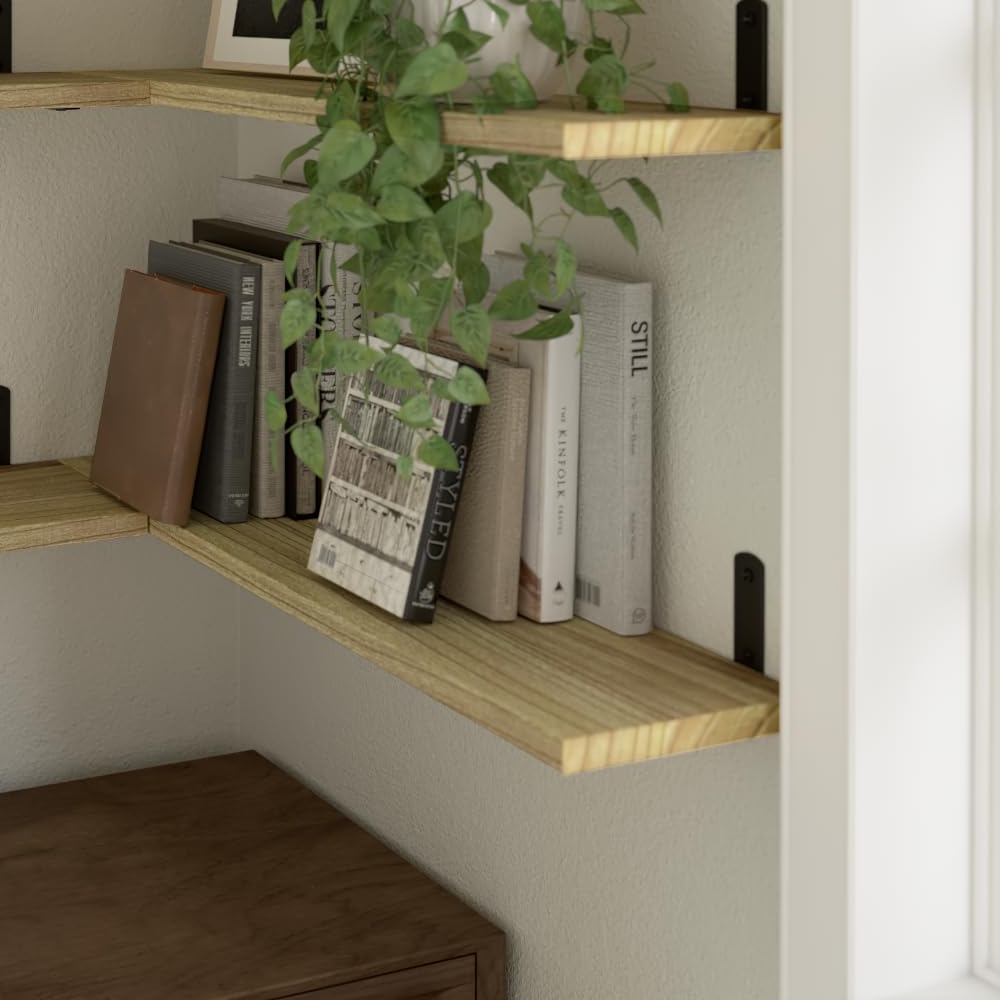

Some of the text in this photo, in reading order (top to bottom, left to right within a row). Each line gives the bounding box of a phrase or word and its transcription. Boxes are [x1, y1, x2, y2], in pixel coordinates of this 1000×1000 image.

[241, 276, 256, 296] NEW
[630, 320, 649, 378] STILL
[557, 429, 568, 499] KINFOLK
